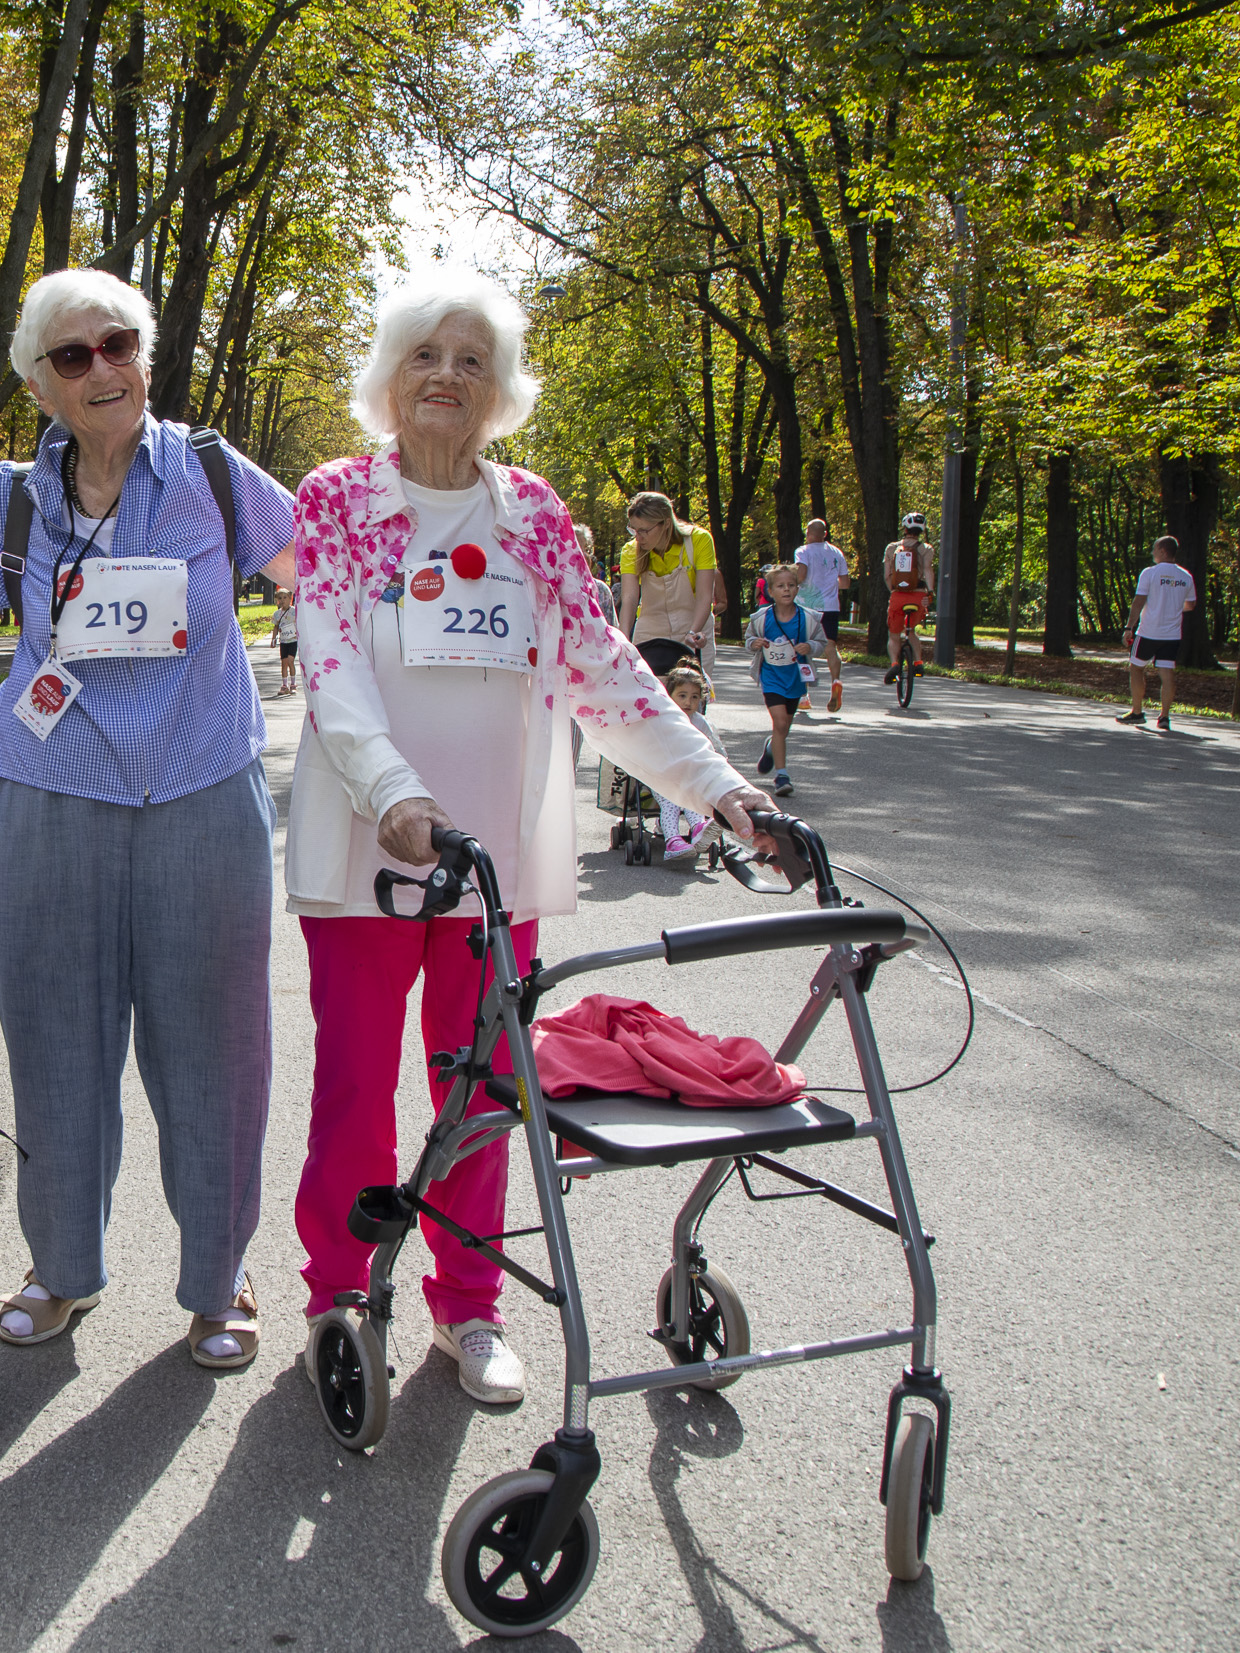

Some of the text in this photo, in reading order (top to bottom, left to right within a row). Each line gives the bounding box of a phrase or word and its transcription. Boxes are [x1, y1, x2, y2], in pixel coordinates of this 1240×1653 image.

[490, 573, 511, 583] NASEN
[85, 600, 148, 635] 219
[442, 604, 509, 638] 226
[769, 651, 786, 661] 552
